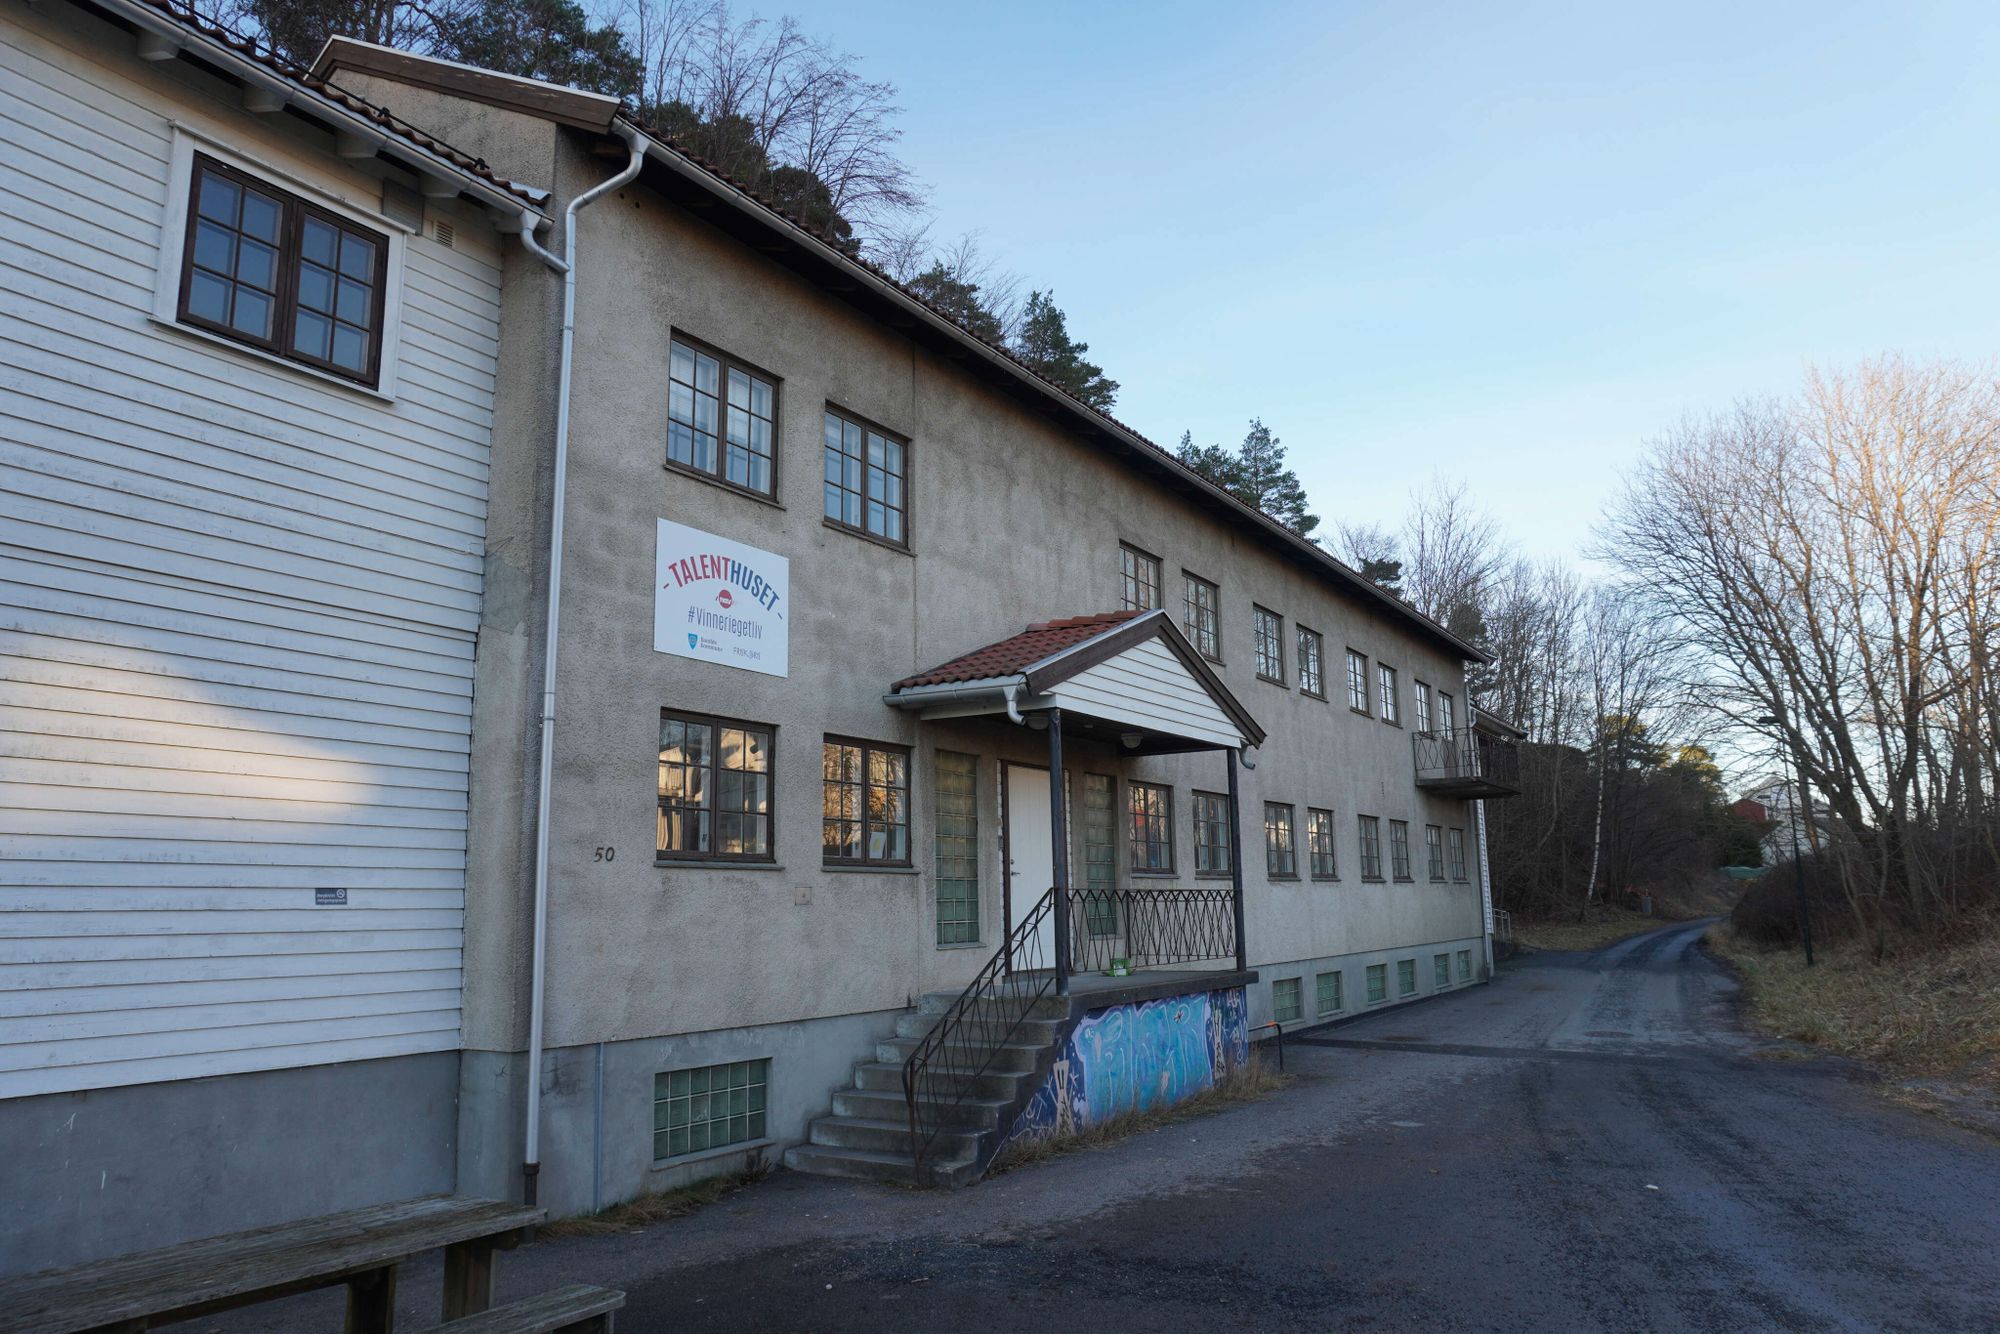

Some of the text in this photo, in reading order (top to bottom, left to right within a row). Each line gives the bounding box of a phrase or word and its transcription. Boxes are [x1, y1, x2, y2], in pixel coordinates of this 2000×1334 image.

[668, 554, 780, 611] TALENTHUSET
[687, 605, 763, 640] #Vinneriegetliv
[593, 846, 615, 862] 50
